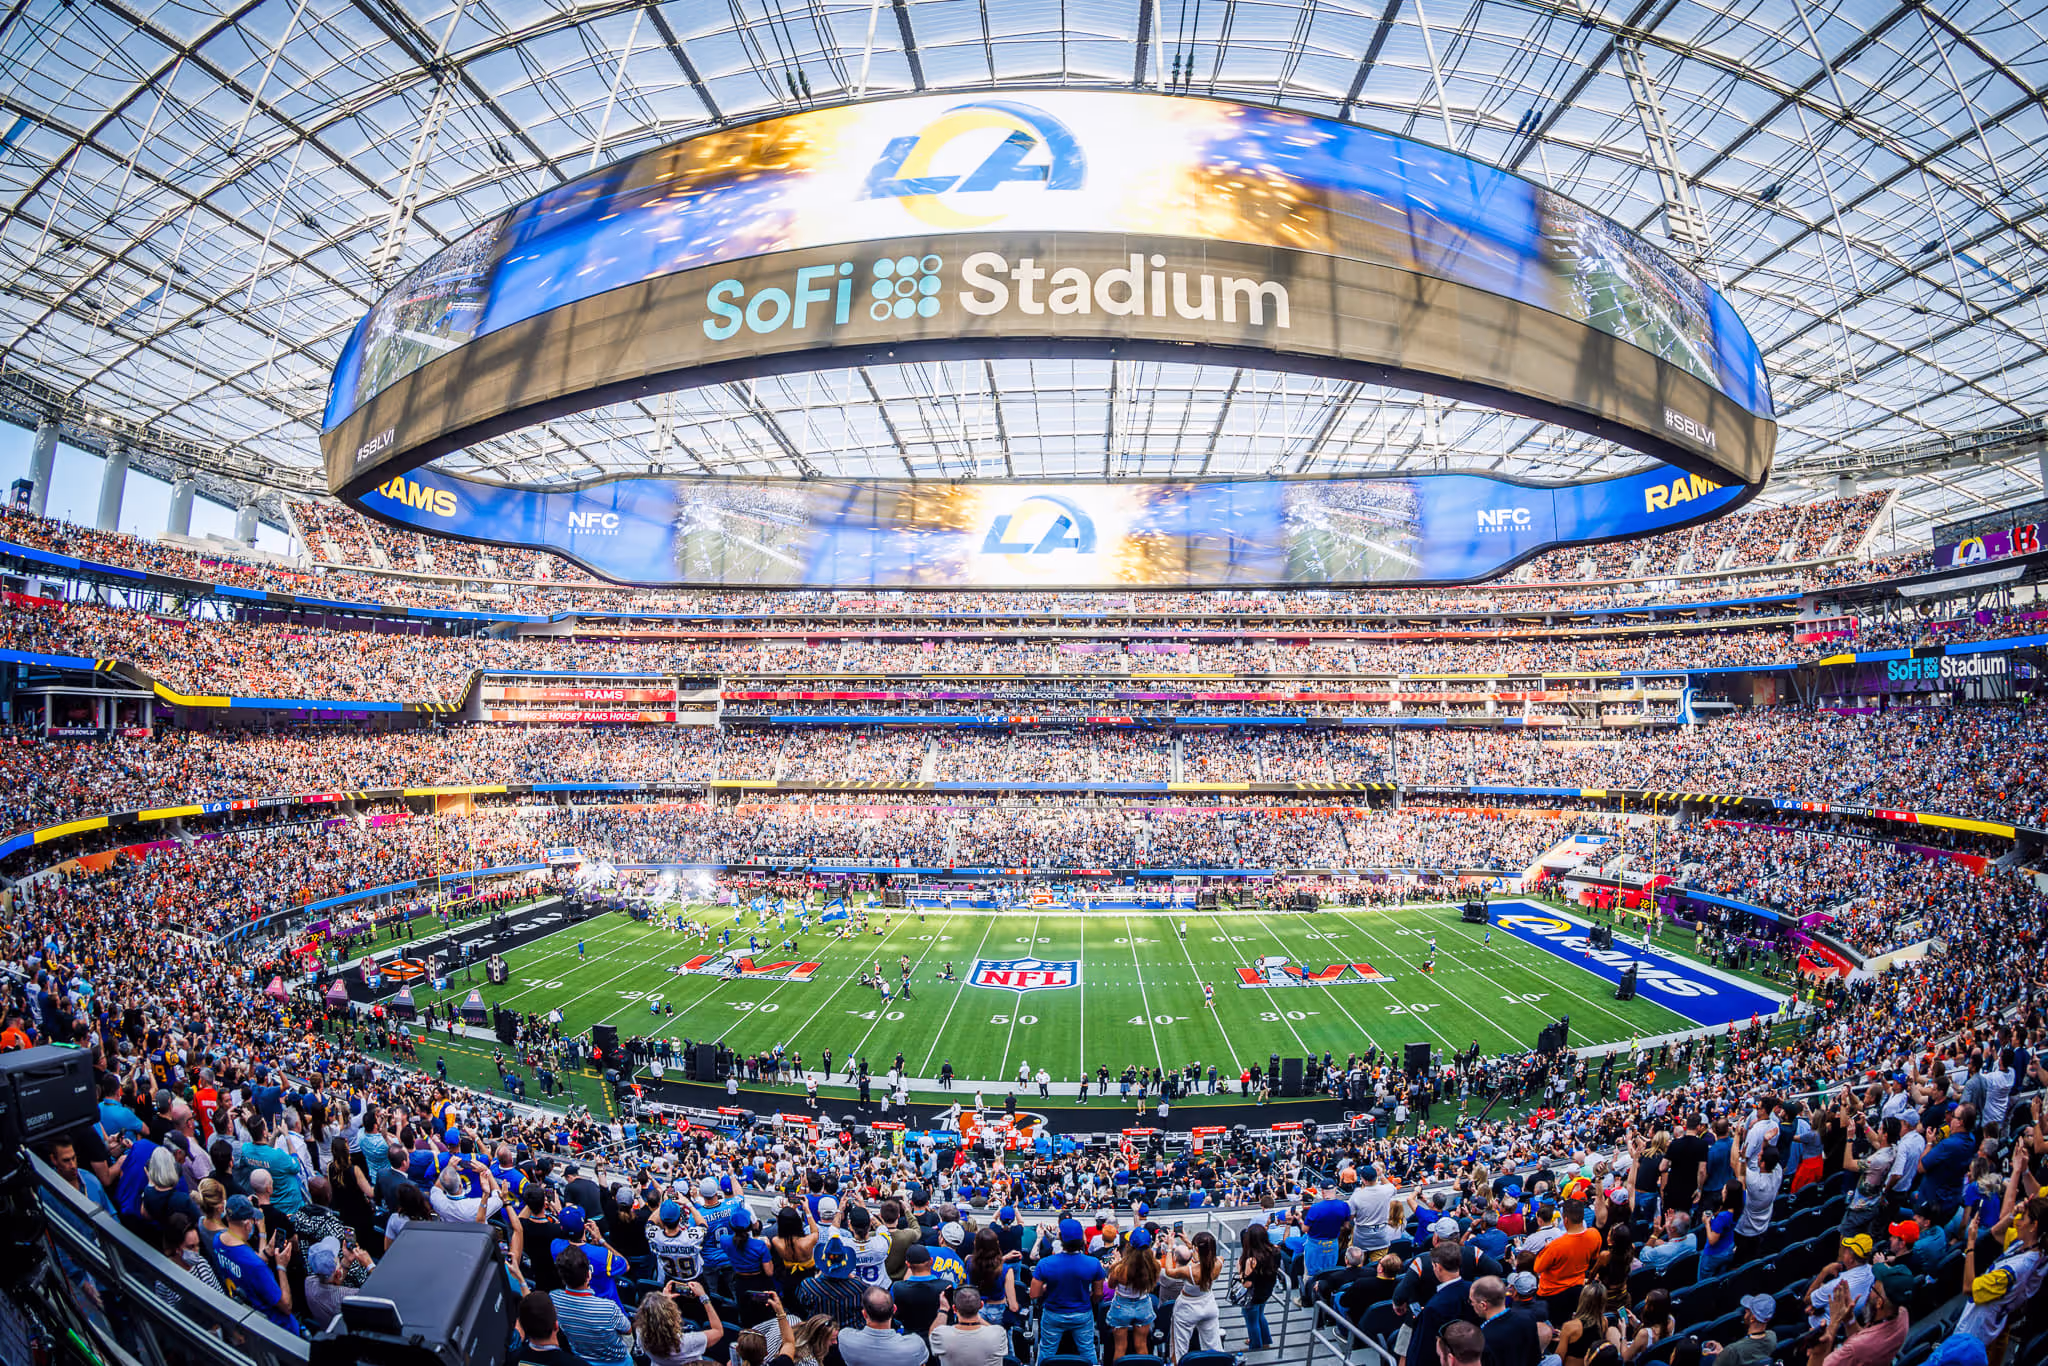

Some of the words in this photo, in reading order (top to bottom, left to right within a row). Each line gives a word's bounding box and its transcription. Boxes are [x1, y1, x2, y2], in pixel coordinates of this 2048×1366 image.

[703, 262, 854, 341] SoFi
[958, 251, 1291, 329] Stadium
[1665, 410, 1716, 447] #SBLVI
[357, 429, 395, 461] #SBLVI
[1644, 473, 1723, 513] RAM
[568, 511, 620, 529] NFC
[1477, 507, 1531, 525] NFC
[1888, 658, 1921, 681] SoFi
[1940, 653, 2006, 678] Stadium
[585, 690, 624, 700] RAMS
[549, 711, 580, 720] HOUSE?
[584, 711, 609, 720] RAMS
[980, 971, 1067, 987] NFL
[620, 990, 665, 1002] 20
[1500, 992, 1542, 1005] 10
[733, 1001, 780, 1013] 30
[1383, 1003, 1430, 1015] 20
[858, 1010, 905, 1021] 40
[989, 1014, 1039, 1025] 50
[1127, 1014, 1174, 1025] 40
[1259, 1010, 1307, 1022] 30
